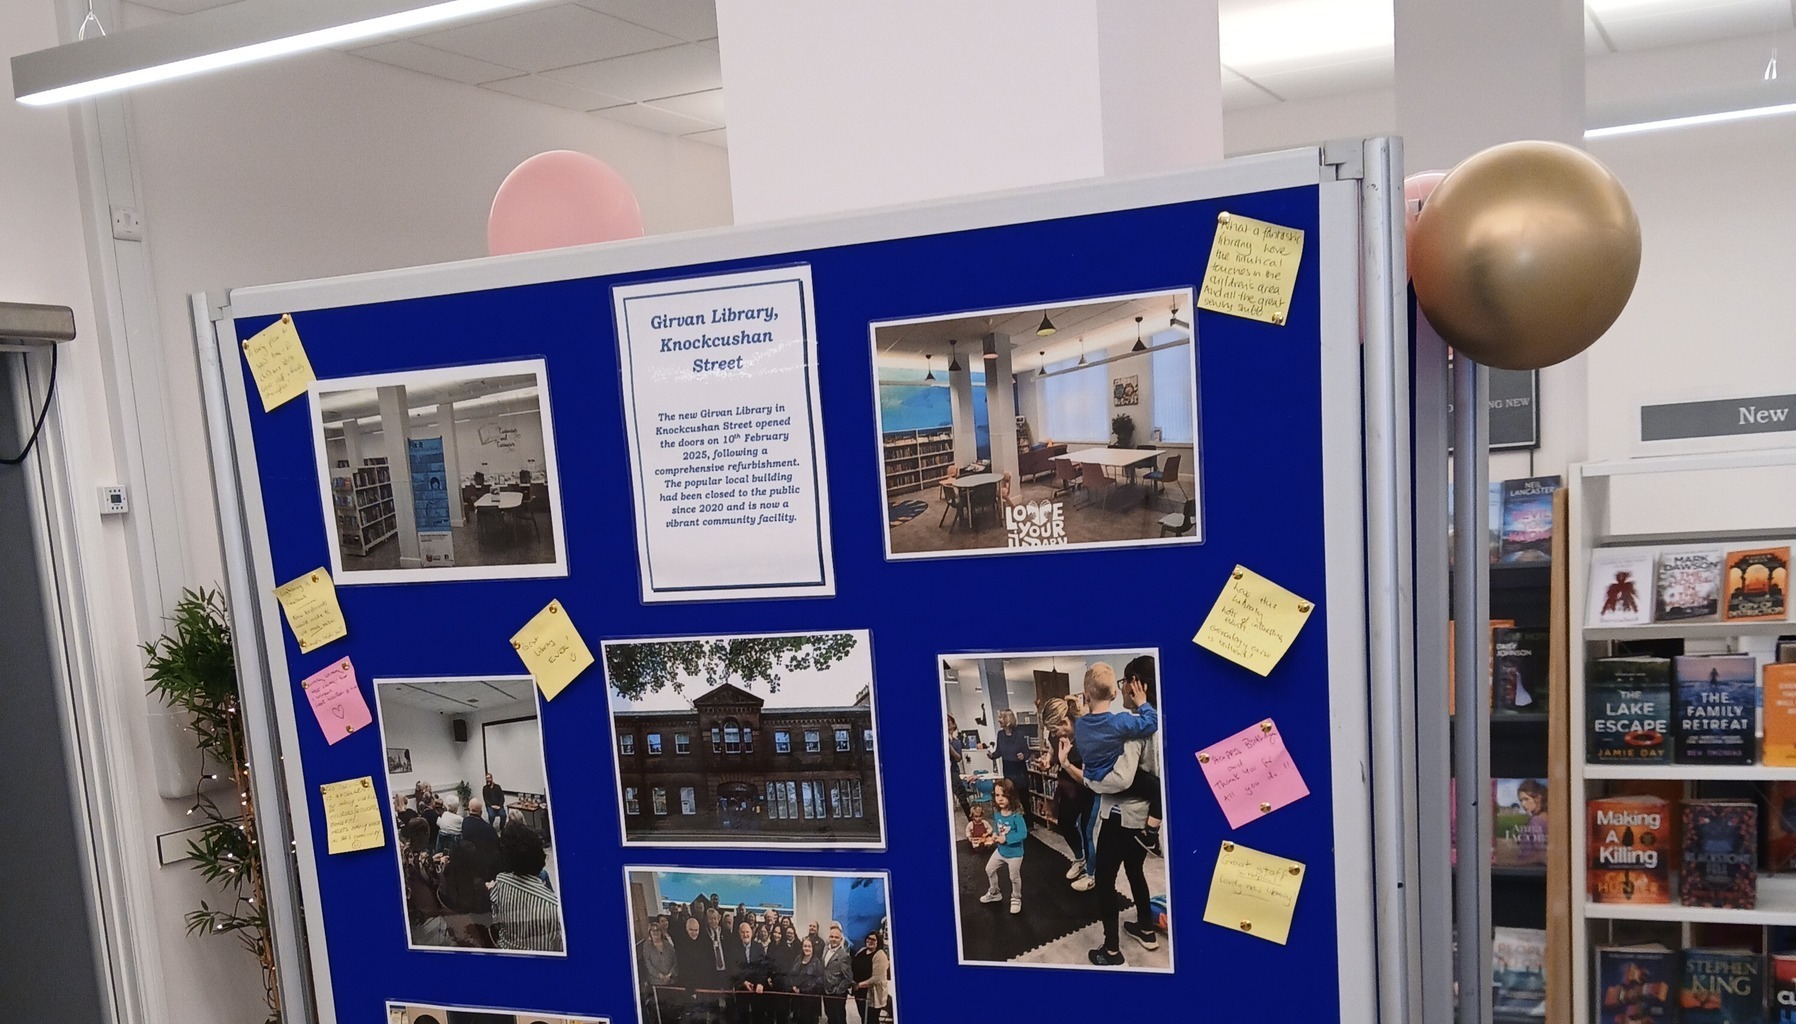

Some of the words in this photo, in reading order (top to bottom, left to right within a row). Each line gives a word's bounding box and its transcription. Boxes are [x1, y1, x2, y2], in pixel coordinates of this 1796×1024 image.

[650, 313, 706, 330] Girvan
[711, 306, 779, 324] Library,
[659, 329, 774, 353] Knockcushan
[692, 355, 744, 373] Street
[1505, 397, 1531, 408] NEW
[658, 412, 676, 422] The
[678, 411, 698, 421] new
[700, 408, 733, 419] Girvan
[735, 405, 773, 416] Library
[775, 403, 786, 413] in
[1738, 406, 1789, 425] New
[655, 423, 720, 436] Knockcushan
[722, 420, 753, 431] Street
[755, 416, 791, 430] opened
[660, 439, 676, 449] the
[678, 438, 705, 448] doors
[707, 437, 720, 445] on
[723, 433, 741, 444] 10th
[744, 432, 790, 443] February
[682, 450, 711, 461] 2025,
[712, 447, 759, 461] following
[761, 447, 769, 455] a
[654, 463, 725, 477] comprehensive
[727, 458, 800, 472] refurbishment.
[664, 479, 682, 489] The
[684, 477, 723, 489] popular
[725, 475, 749, 485] local
[751, 472, 793, 483] building
[659, 492, 678, 502] had
[680, 492, 703, 501] been
[705, 489, 736, 499] closed
[738, 488, 748, 497] to
[751, 487, 767, 497] the
[769, 485, 801, 498] public
[671, 505, 697, 514] since
[699, 503, 724, 513] 2020
[726, 502, 745, 511] and
[748, 501, 757, 510] is
[759, 501, 780, 510] now
[665, 517, 700, 528] vibrant
[702, 514, 757, 526] community
[756, 513, 797, 526] facility.
[1018, 521, 1066, 539] YOUR
[1663, 561, 1719, 571] DAWSON
[1674, 555, 1708, 564] MARK
[1620, 690, 1642, 699] THE
[1700, 692, 1730, 704] THE
[1606, 703, 1654, 716] LAKE
[1686, 706, 1744, 717] FAMILY
[1594, 719, 1667, 733] ESCAPE
[1682, 719, 1748, 730] RETREAT
[1598, 748, 1634, 757] JAMIE
[1640, 748, 1665, 757] DAY
[1597, 809, 1662, 830] Making
[1605, 829, 1620, 844] A
[1600, 846, 1658, 869] Killing
[1687, 960, 1759, 975] STEPHEN
[1692, 975, 1751, 996] KING
